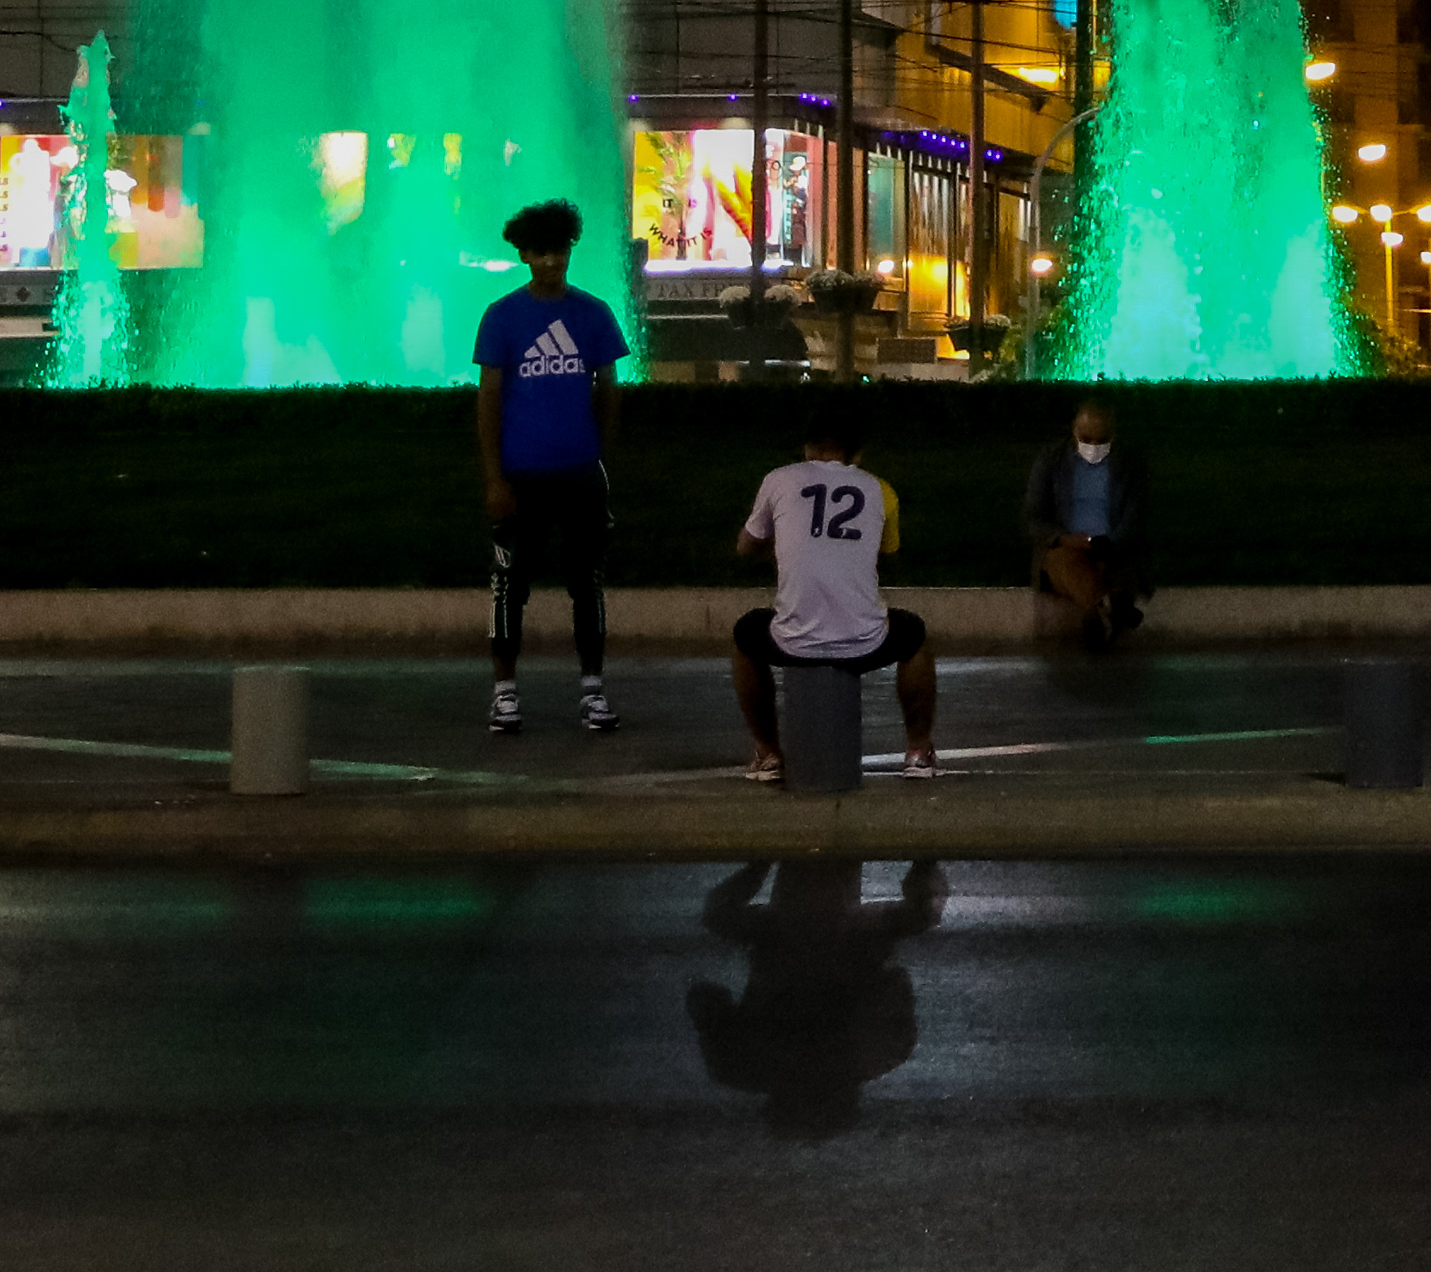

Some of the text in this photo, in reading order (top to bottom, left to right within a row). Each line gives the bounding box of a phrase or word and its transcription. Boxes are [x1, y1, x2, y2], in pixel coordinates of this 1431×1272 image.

[663, 199, 674, 208] IT
[649, 223, 687, 249] WHAT
[656, 284, 693, 297] TAX
[518, 353, 587, 378] adidas
[801, 483, 865, 540] 12
